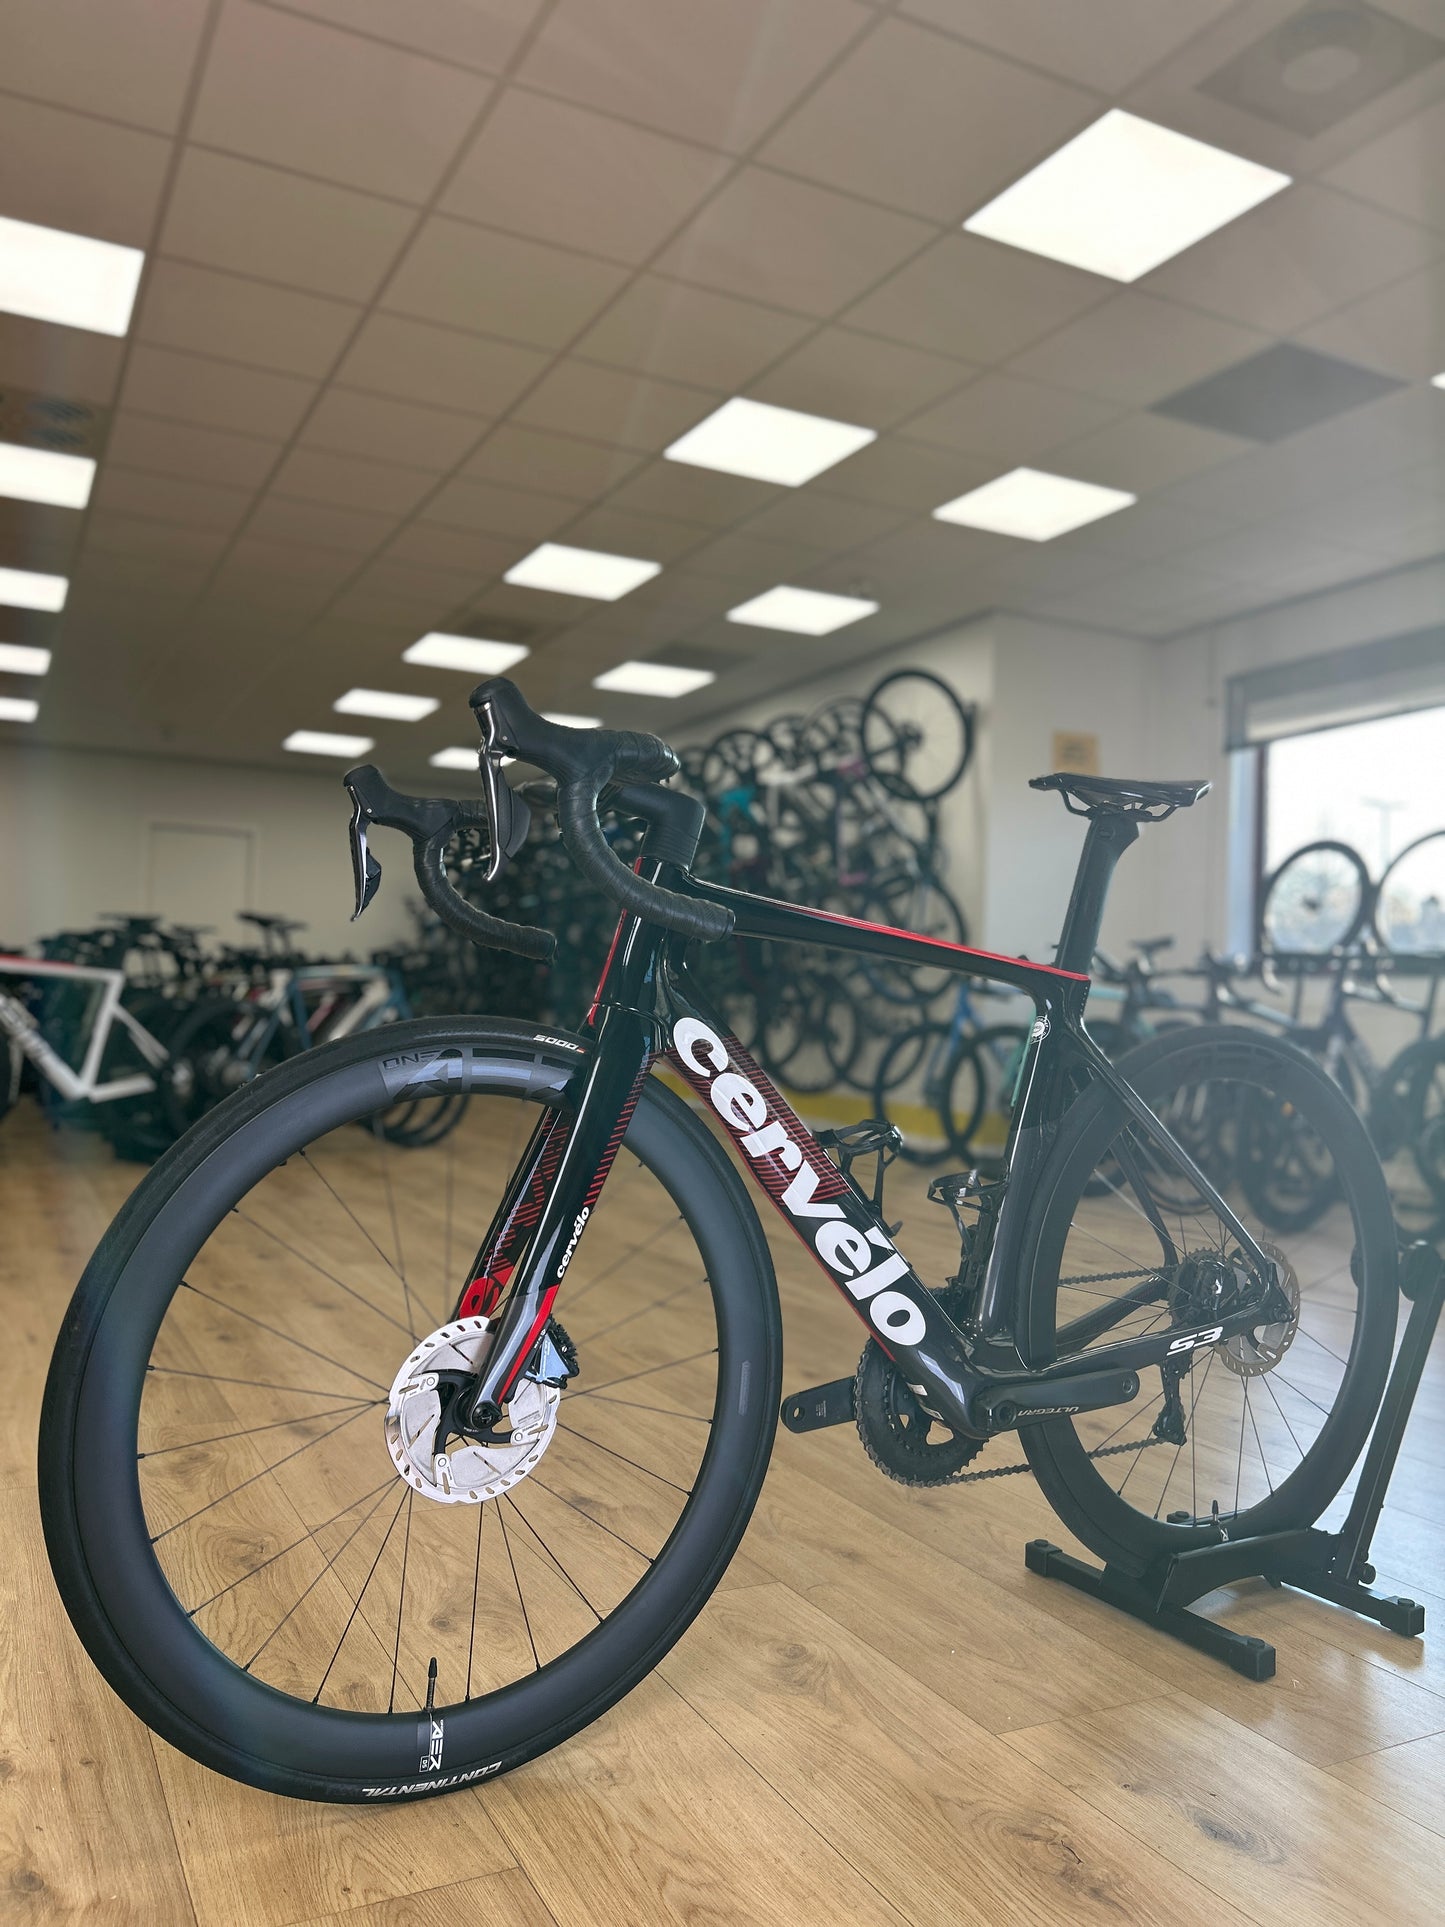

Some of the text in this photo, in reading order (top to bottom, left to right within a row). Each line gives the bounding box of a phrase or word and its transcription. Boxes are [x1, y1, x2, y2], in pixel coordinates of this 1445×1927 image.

[533, 1034, 579, 1050] 5000
[673, 1017, 926, 1346] cervélo
[556, 1206, 590, 1278] cervélo
[1167, 1326, 1224, 1356] S3
[1017, 1406, 1079, 1417] ULTEGRA
[362, 1761, 502, 1797] CONTINENTAL
